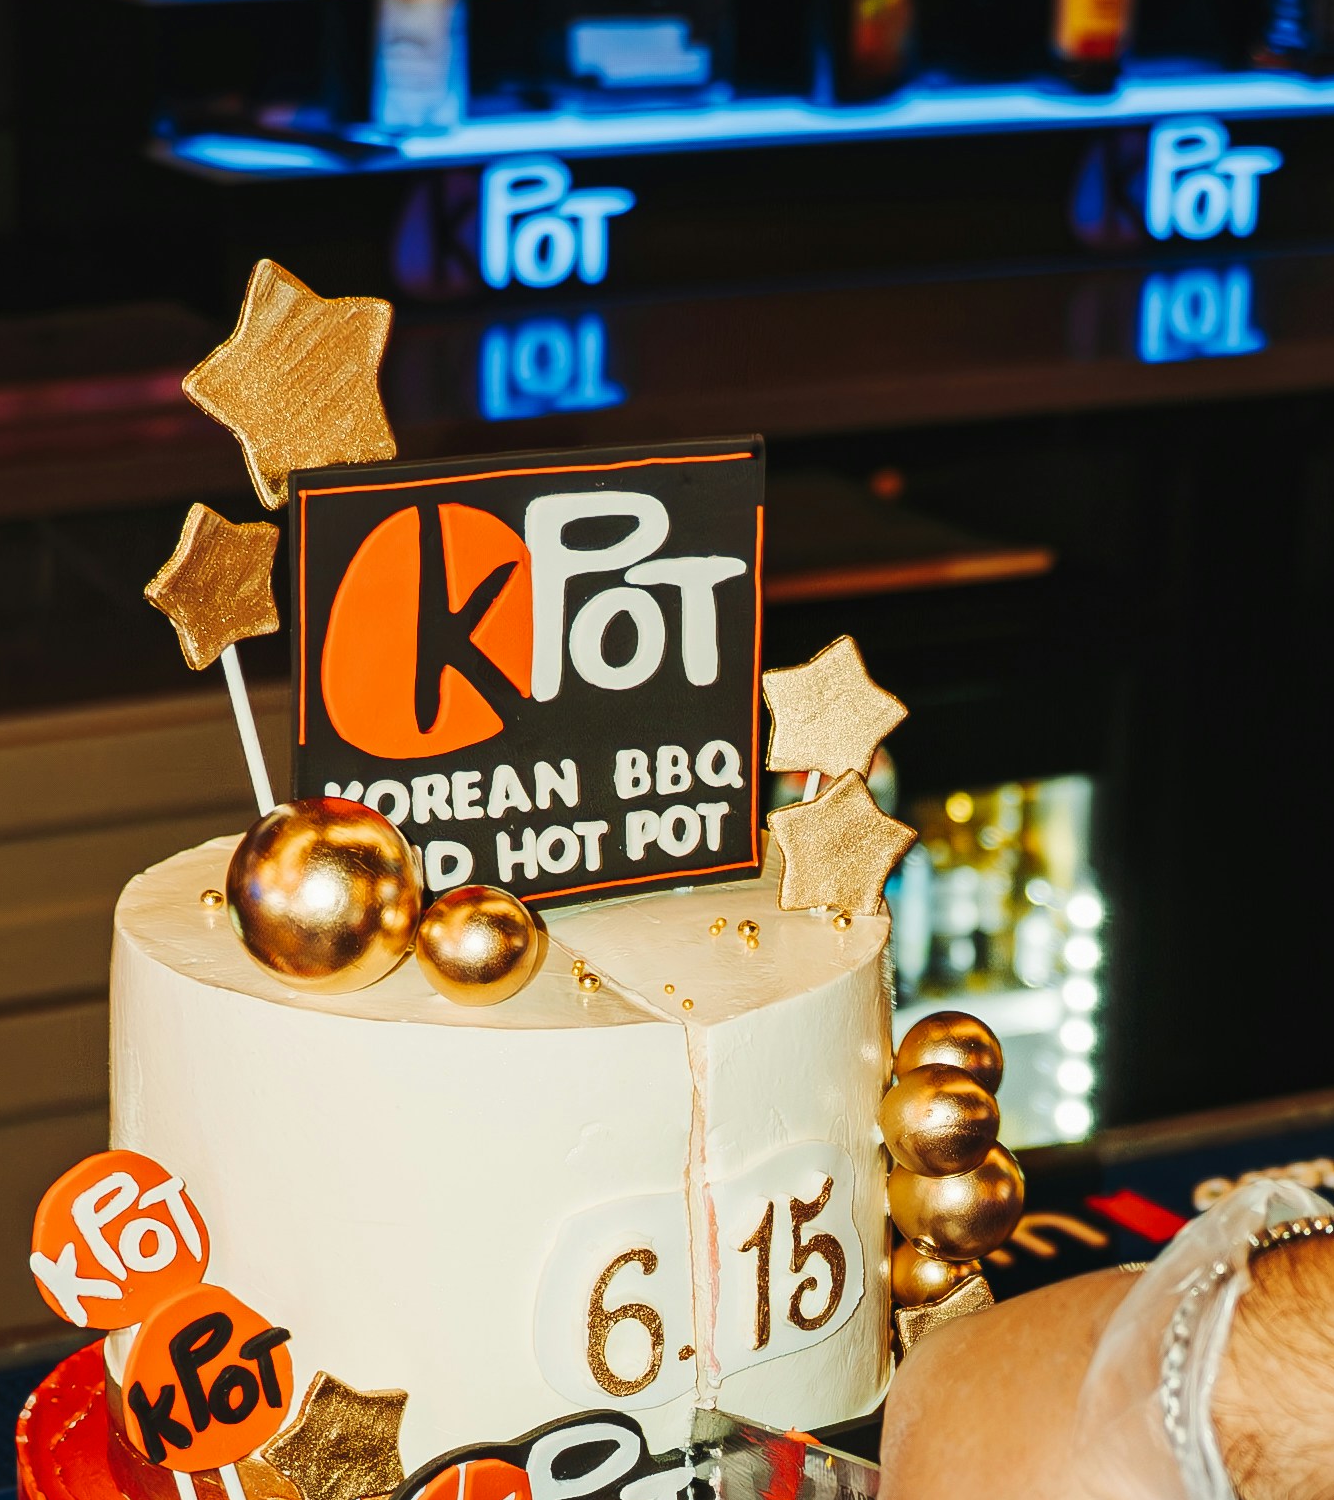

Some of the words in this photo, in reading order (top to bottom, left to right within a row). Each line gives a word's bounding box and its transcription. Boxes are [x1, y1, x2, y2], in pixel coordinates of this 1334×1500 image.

[322, 491, 747, 759] KPOT
[495, 820, 609, 883] HOT
[625, 802, 731, 862] POT
[613, 739, 745, 800] BBQ
[30, 1171, 202, 1327] KPOT
[127, 1311, 292, 1465] KPOT
